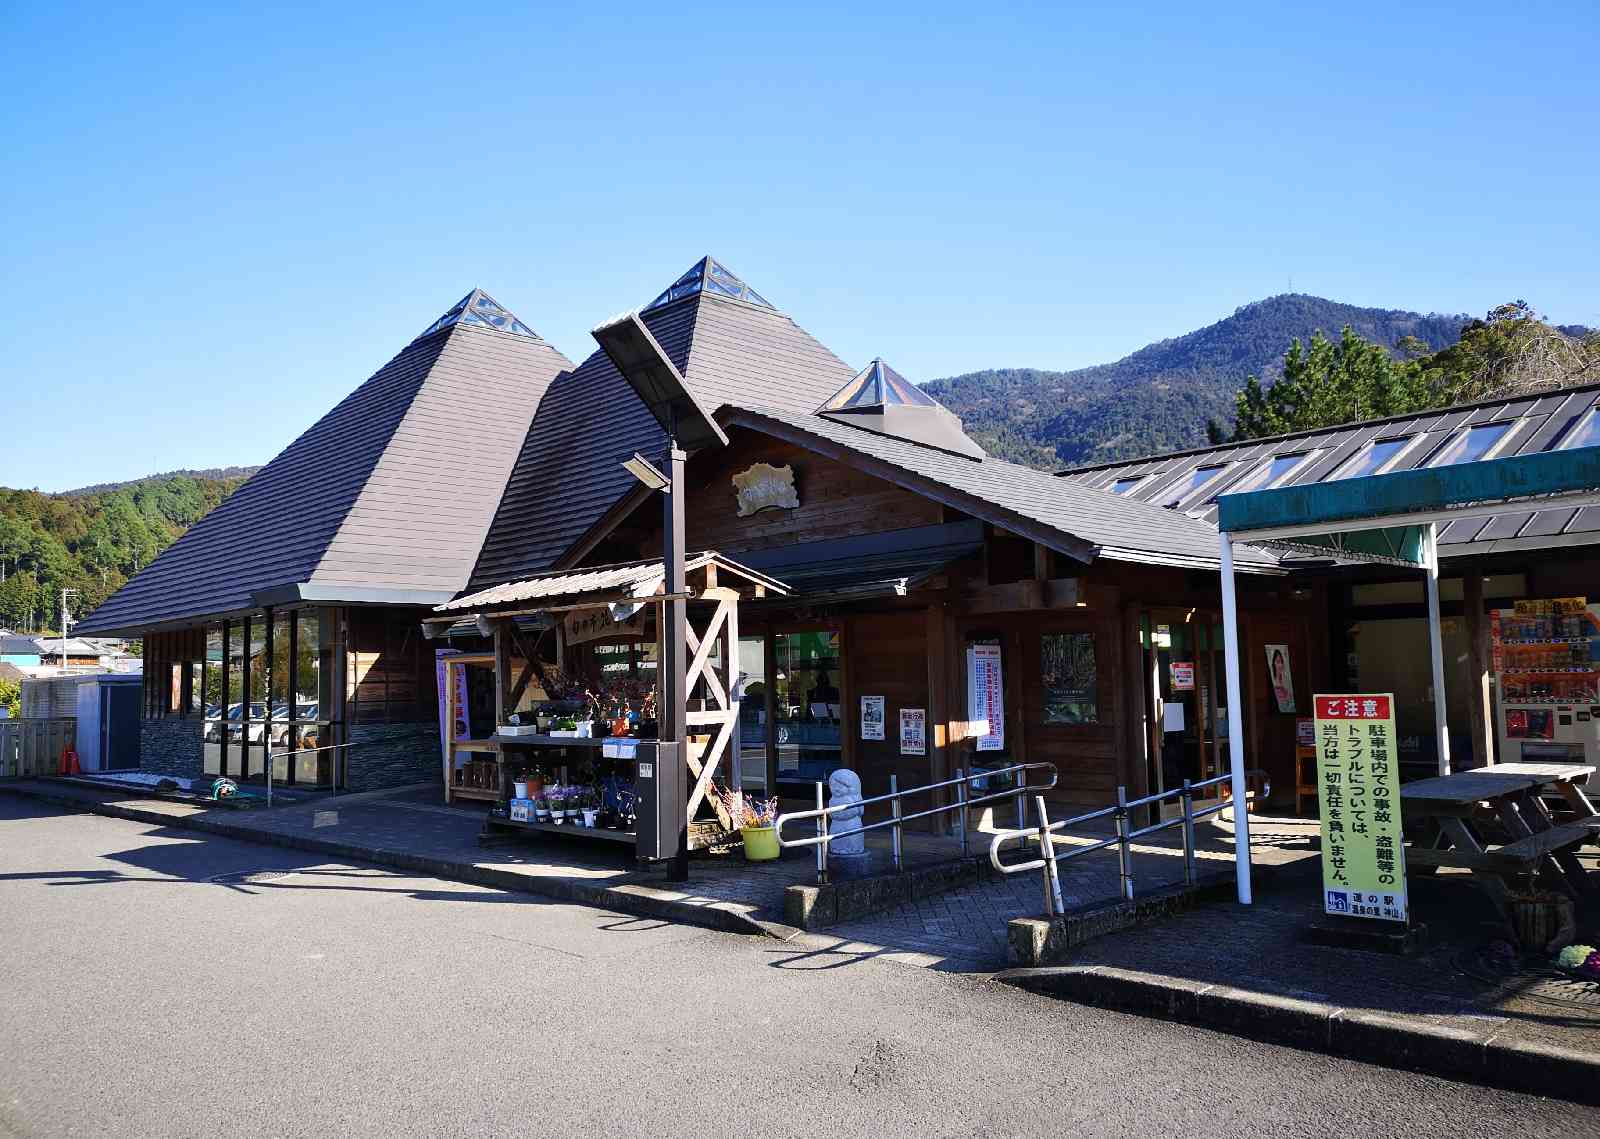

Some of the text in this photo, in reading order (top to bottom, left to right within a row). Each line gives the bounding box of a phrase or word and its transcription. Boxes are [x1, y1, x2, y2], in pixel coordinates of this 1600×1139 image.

[1326, 700, 1379, 717] ご注意
[1322, 724, 1350, 886] 当方は一切責任を負いません。
[1348, 724, 1369, 839] トラブルについては、
[1368, 724, 1395, 885] 駐車場内での事故・盗難等の
